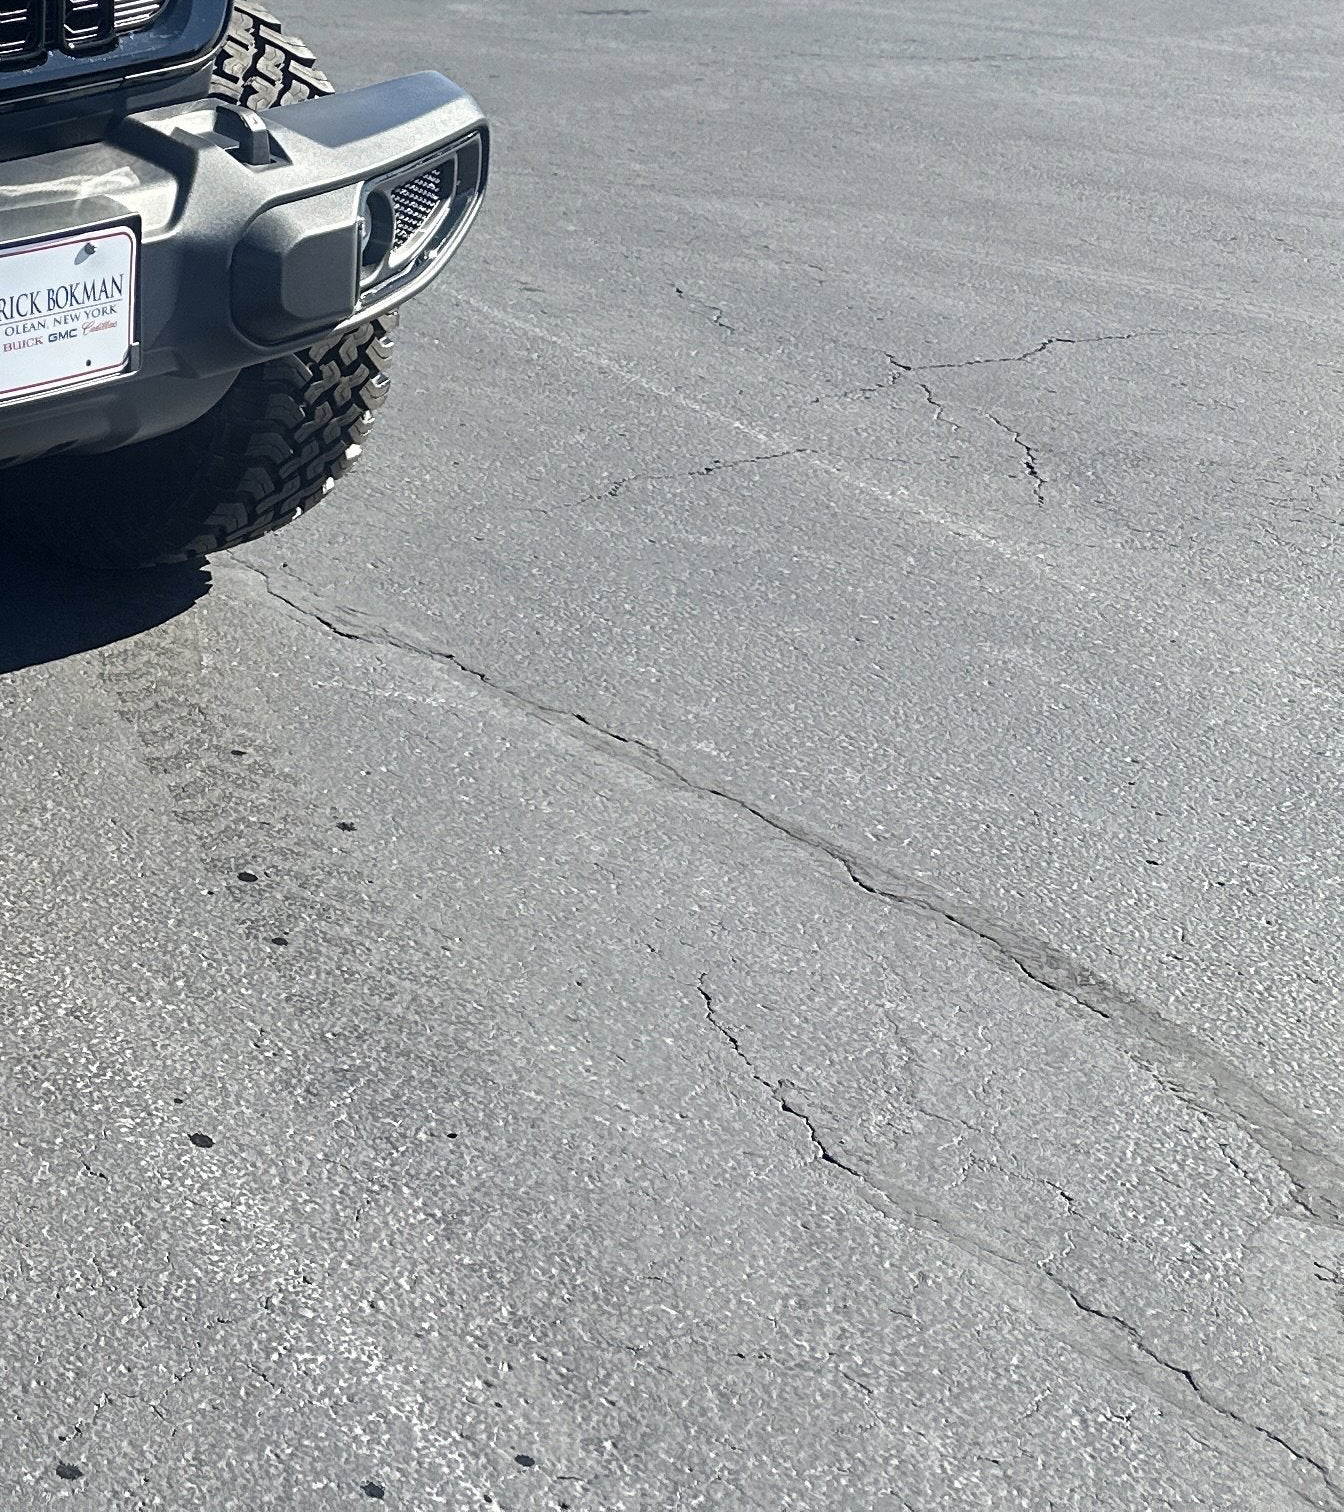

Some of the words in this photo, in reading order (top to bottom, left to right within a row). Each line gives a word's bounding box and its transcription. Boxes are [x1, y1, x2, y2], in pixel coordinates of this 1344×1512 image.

[46, 273, 124, 312] BOKMAN
[52, 312, 81, 328] NEW
[83, 304, 118, 320] YORK
[2, 335, 44, 353] BUICK
[48, 328, 78, 343] GMC
